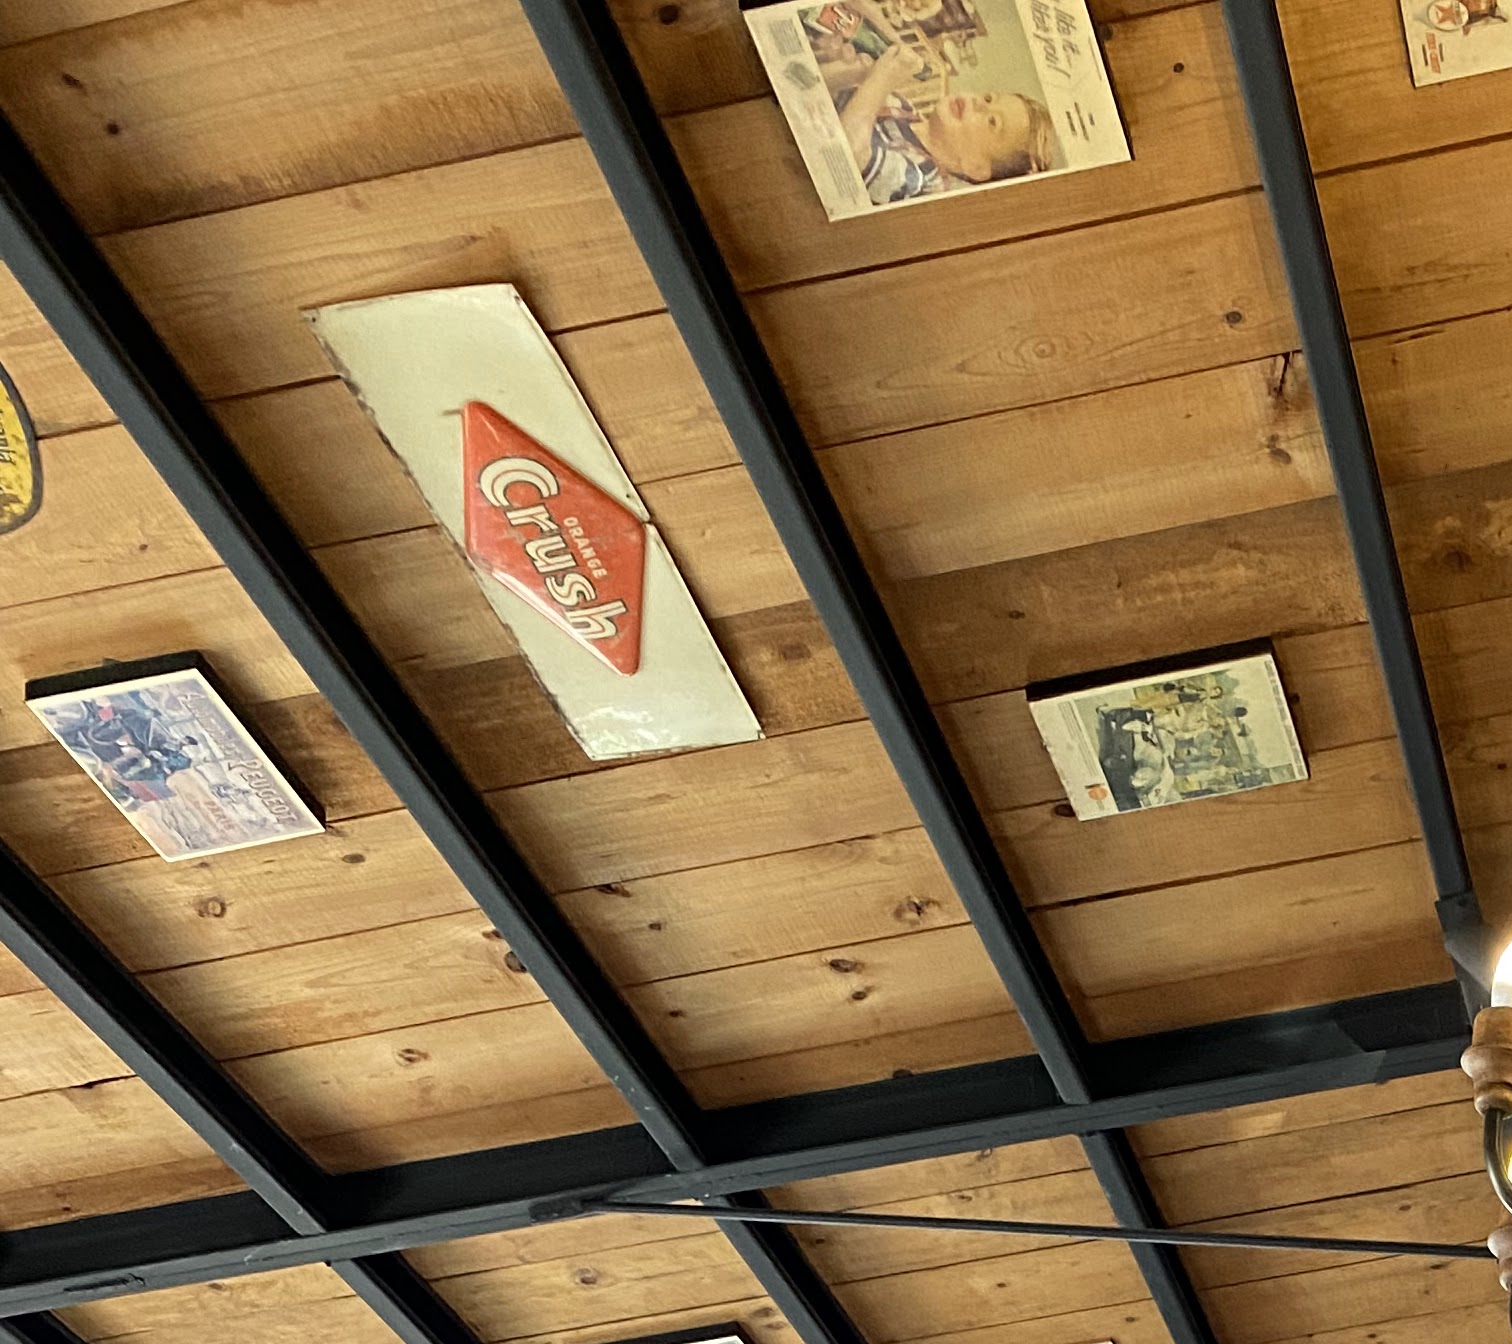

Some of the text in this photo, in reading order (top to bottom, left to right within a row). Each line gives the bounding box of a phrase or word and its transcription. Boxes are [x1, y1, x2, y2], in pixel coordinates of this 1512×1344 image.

[478, 456, 628, 640] Crush
[563, 516, 608, 579] ORANGE
[227, 757, 299, 825] PEUGEOT
